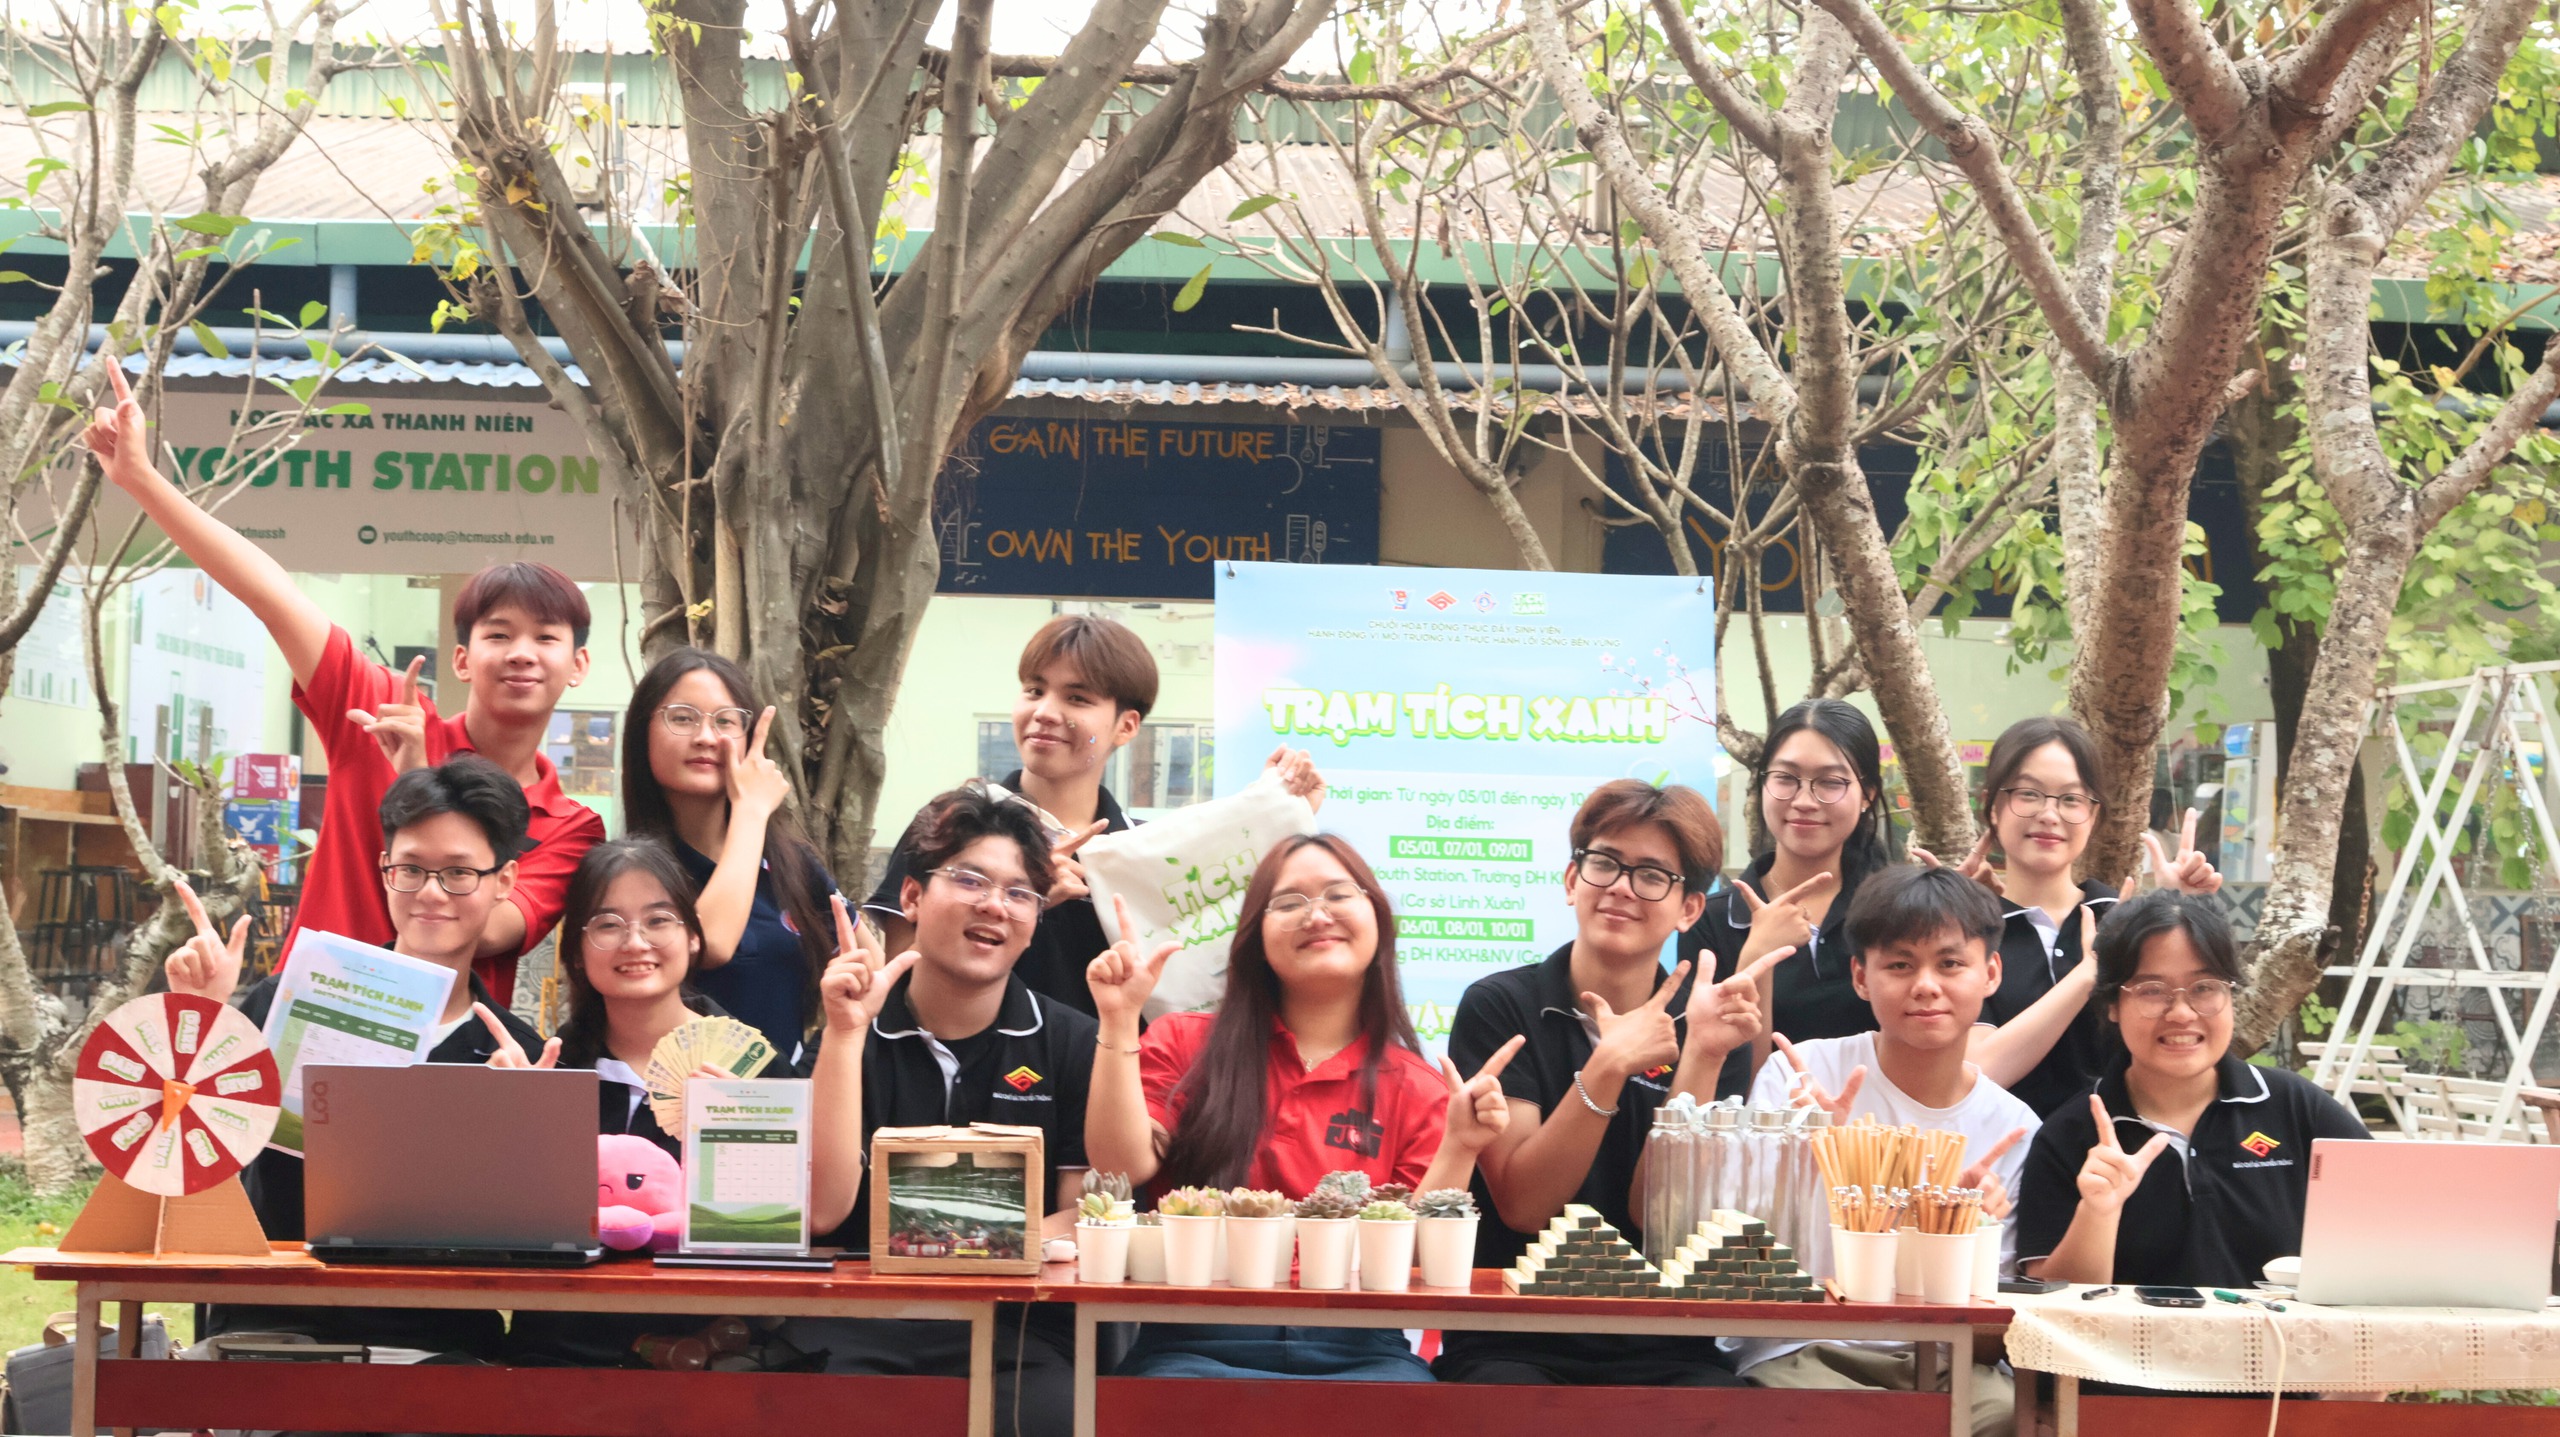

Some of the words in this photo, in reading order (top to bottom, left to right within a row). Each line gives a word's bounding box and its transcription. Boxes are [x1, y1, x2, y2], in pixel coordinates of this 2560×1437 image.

[382, 412, 466, 432] THANH
[475, 411, 534, 434] NIÊN
[1092, 421, 1150, 460] THE
[1159, 427, 1275, 465] FUTURE
[170, 446, 352, 489] YOUTH
[373, 451, 602, 495] STATION
[987, 527, 1073, 566] OWN
[1086, 527, 1141, 564] THE
[1156, 525, 1272, 566] YOUTH
[1263, 686, 1397, 748] TRẠM
[1403, 681, 1523, 740] TÍCH
[1528, 695, 1669, 745] XANH
[1357, 786, 1393, 805] gian:
[1419, 788, 1456, 808] ngày
[1458, 789, 1498, 805] 05/01
[1531, 792, 1567, 810] ngày
[1426, 814, 1451, 832] Địa
[1454, 814, 1496, 831] điểm:
[1397, 839, 1441, 857] 05/01,
[1443, 841, 1487, 858] 07/01,
[1488, 842, 1528, 859] 09/01
[1414, 866, 1469, 883] Station,
[1525, 870, 1547, 885] ĐH
[1450, 894, 1481, 909] Linh
[1398, 918, 1442, 937] 06/01,
[1444, 919, 1488, 938] 08/01,
[1490, 920, 1528, 939] 10/01
[1411, 946, 1433, 962] ĐH
[1436, 947, 1515, 963] KHXH&NV
